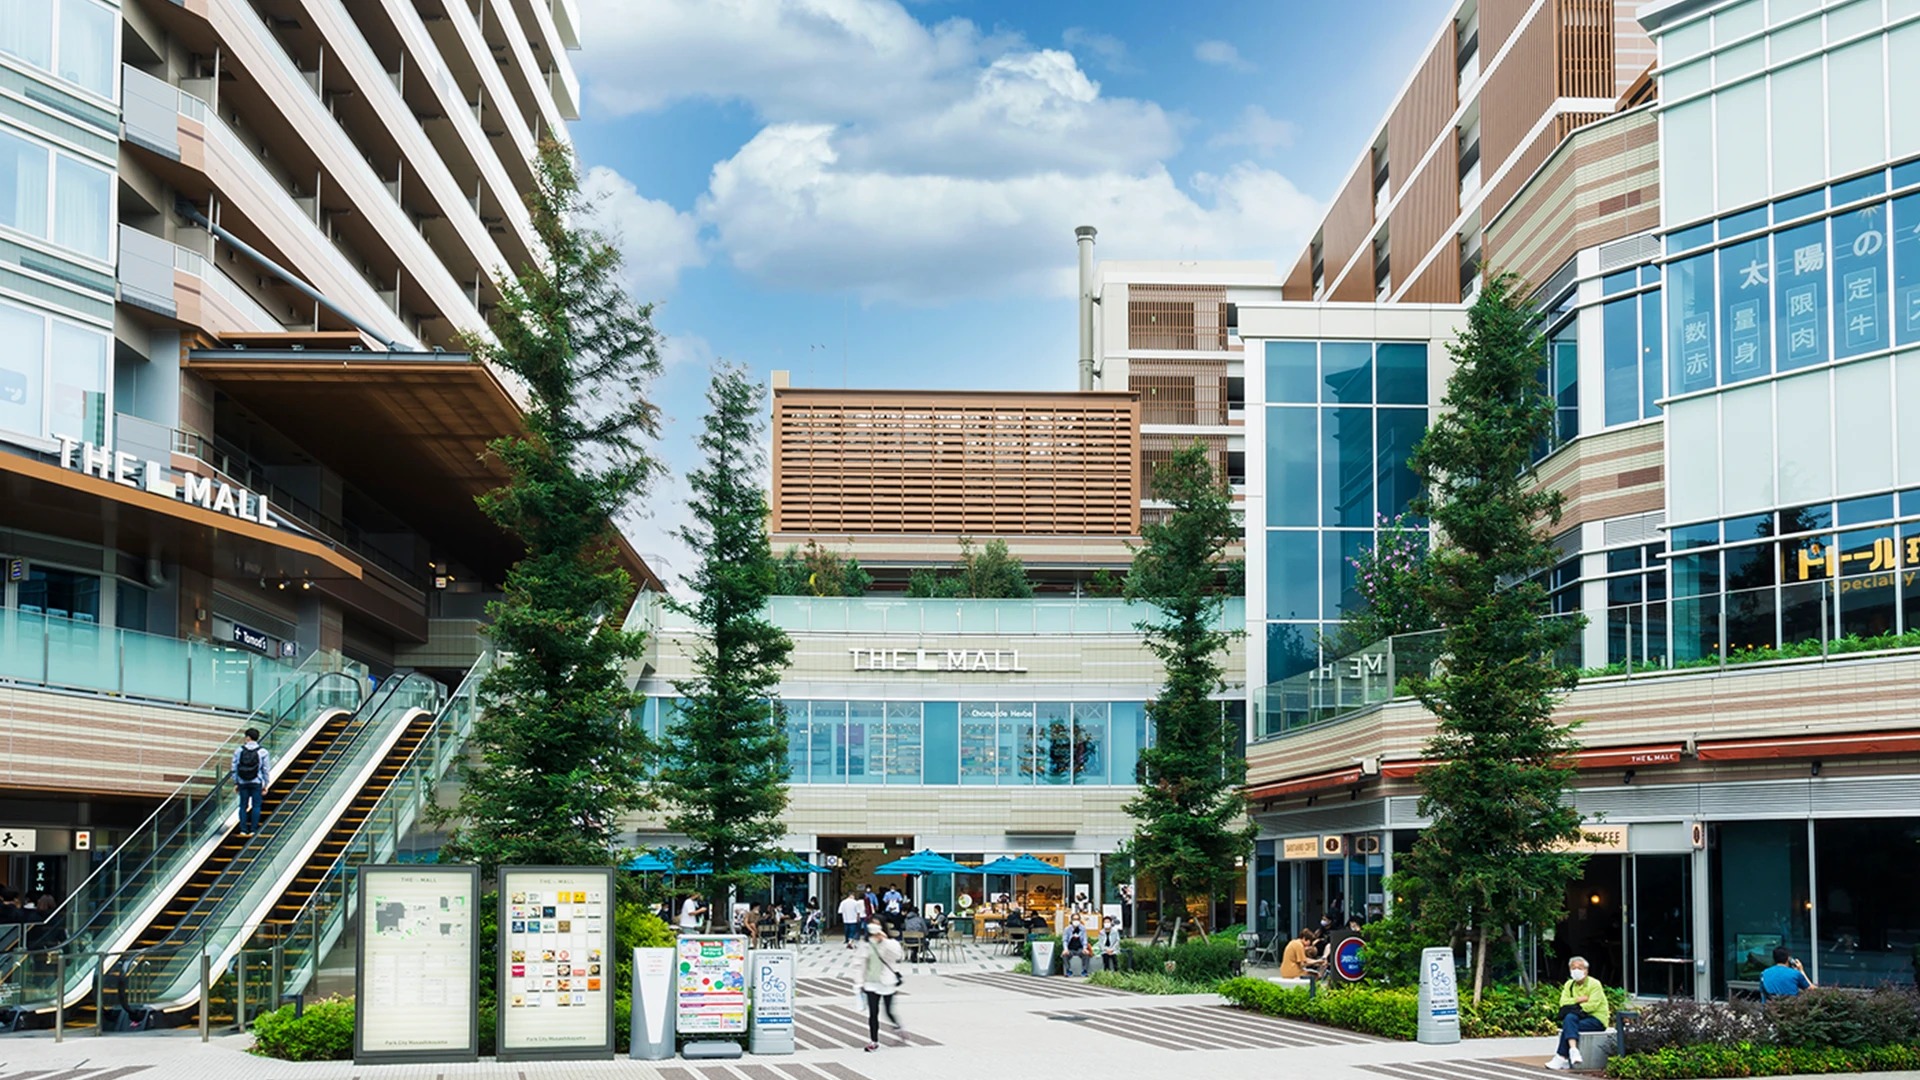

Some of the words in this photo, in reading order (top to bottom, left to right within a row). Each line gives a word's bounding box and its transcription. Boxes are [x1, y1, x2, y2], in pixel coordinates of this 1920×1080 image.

[52, 433, 138, 487] THE
[184, 472, 278, 527] MALL
[1829, 571, 1916, 594] Specialy
[849, 647, 908, 672] THE
[947, 648, 1028, 673] MALL
